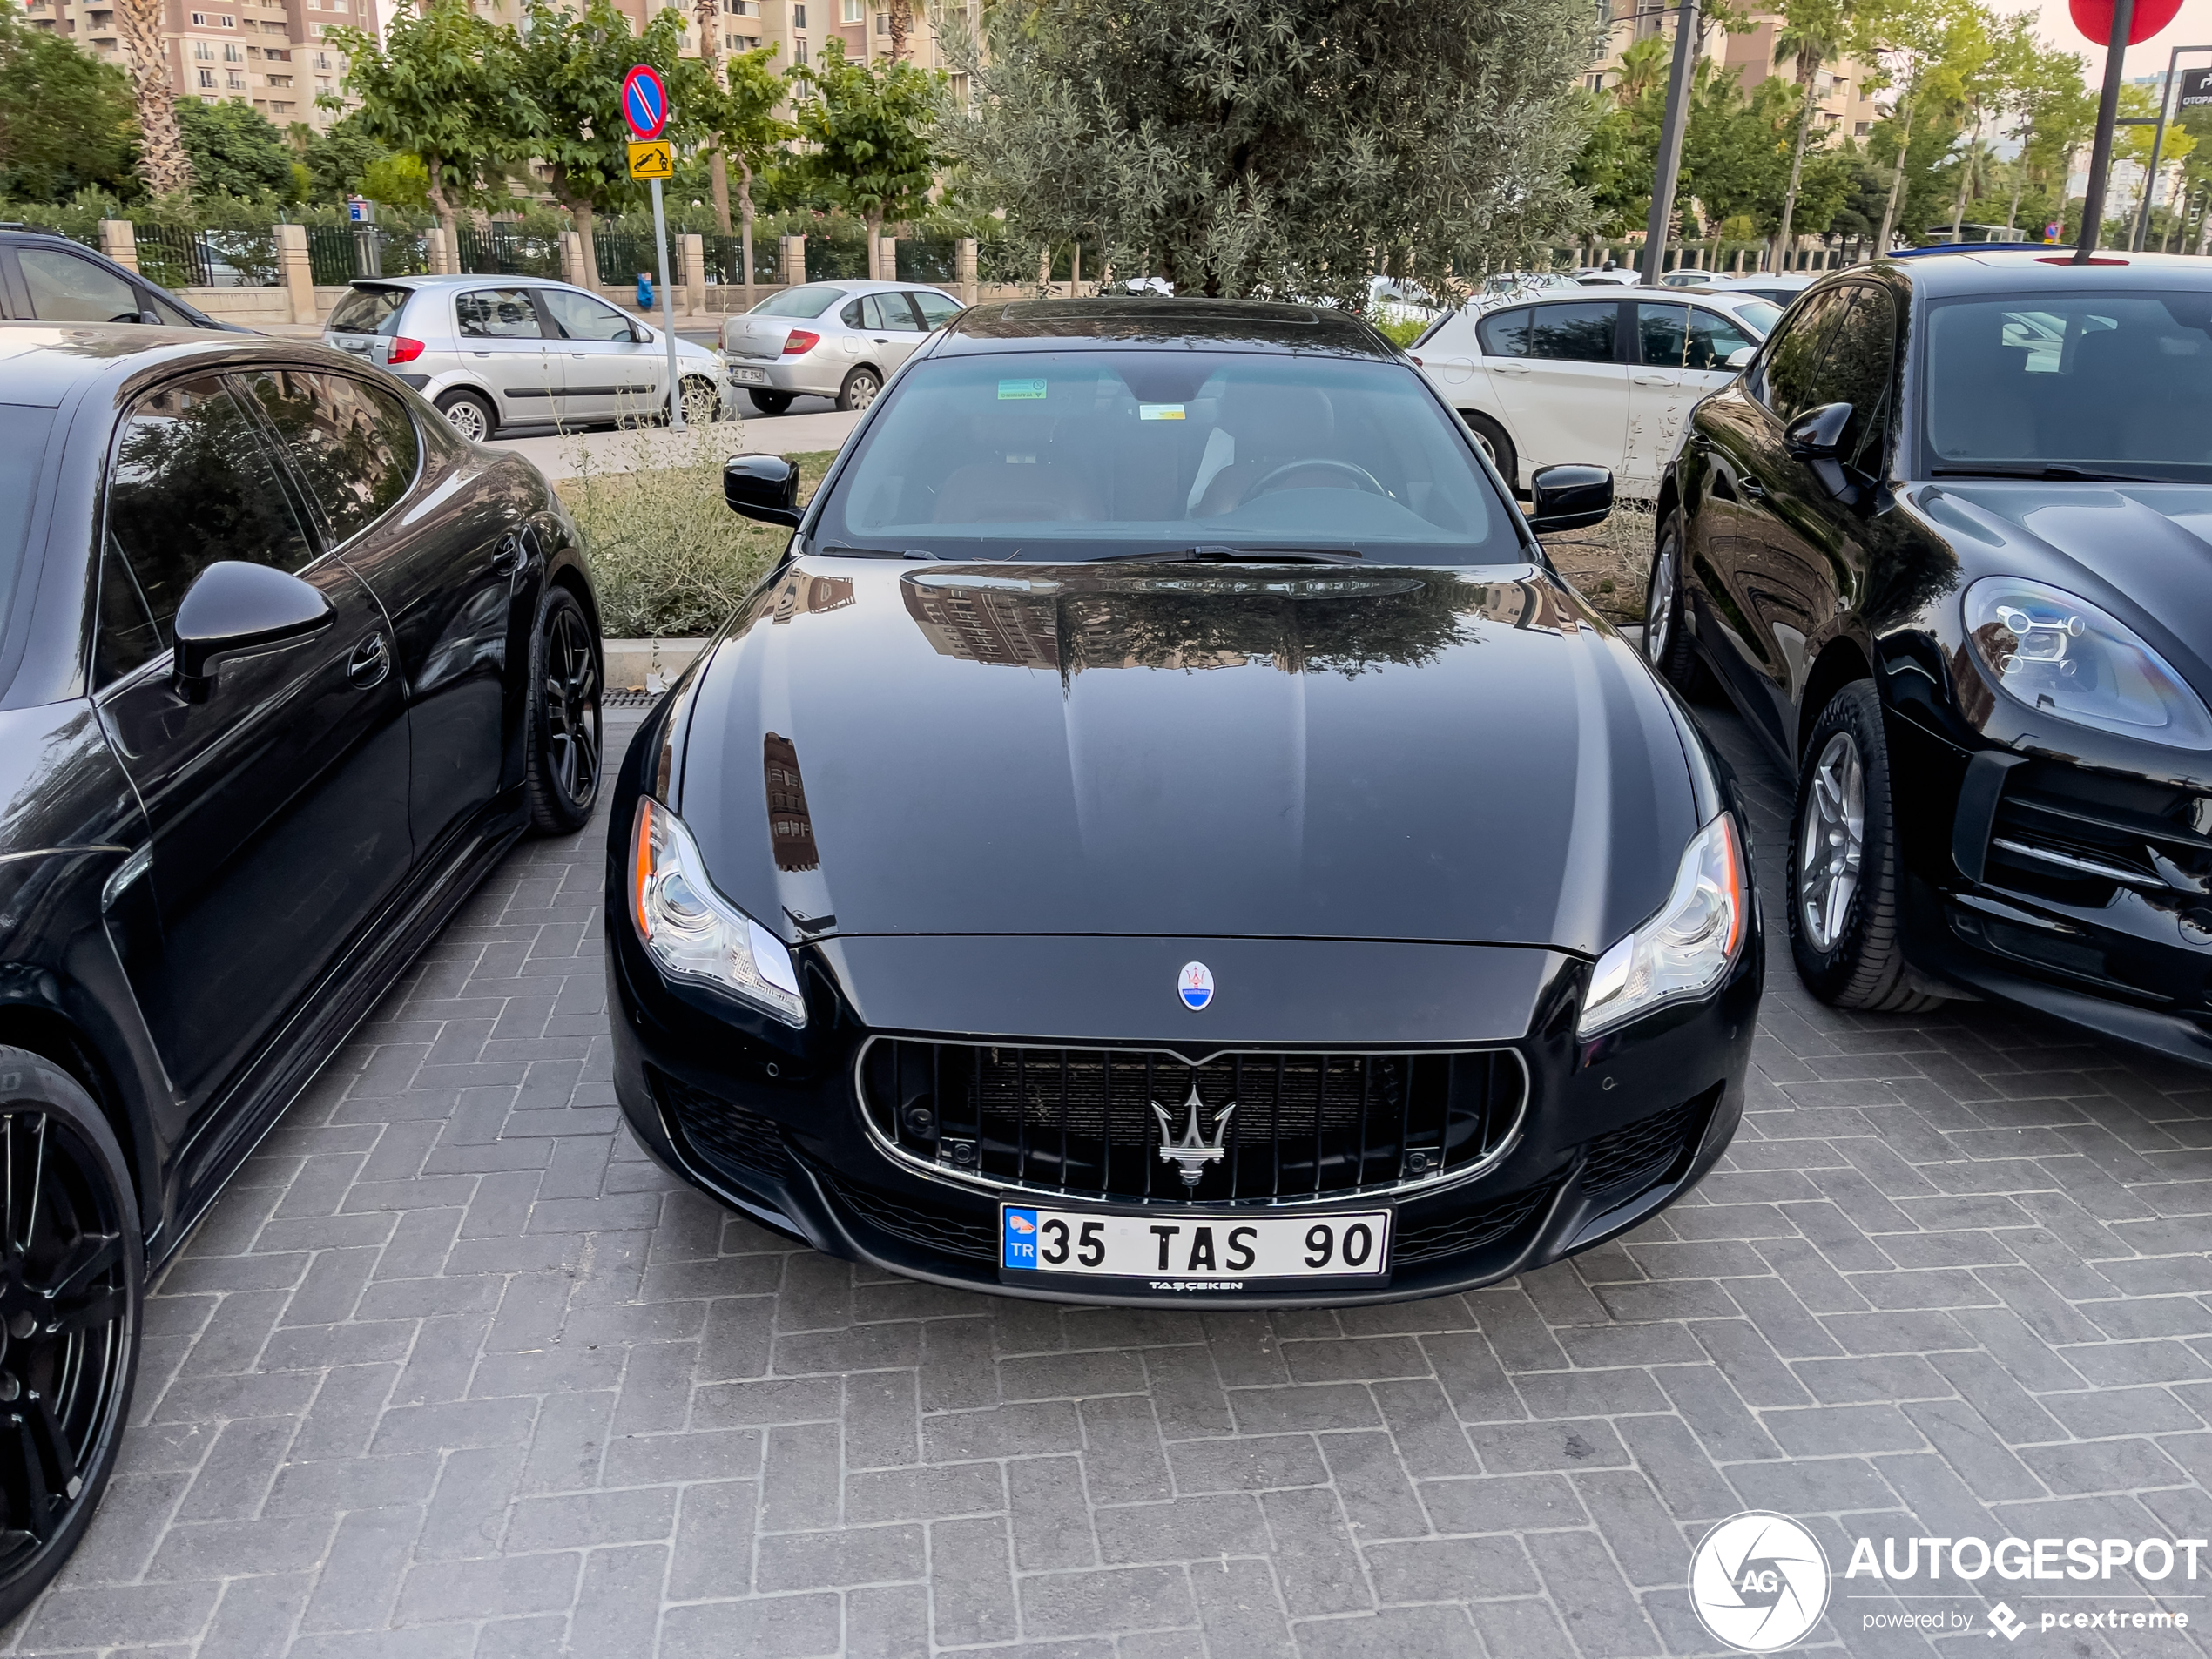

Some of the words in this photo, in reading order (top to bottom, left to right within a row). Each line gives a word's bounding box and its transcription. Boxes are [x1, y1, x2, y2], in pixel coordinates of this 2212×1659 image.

[1010, 1243, 1034, 1258] TR
[1041, 1218, 1106, 1267] 35
[1150, 1225, 1258, 1271] TAS
[1304, 1223, 1373, 1269] 90
[1149, 1281, 1244, 1291] TAŞÇEKEN
